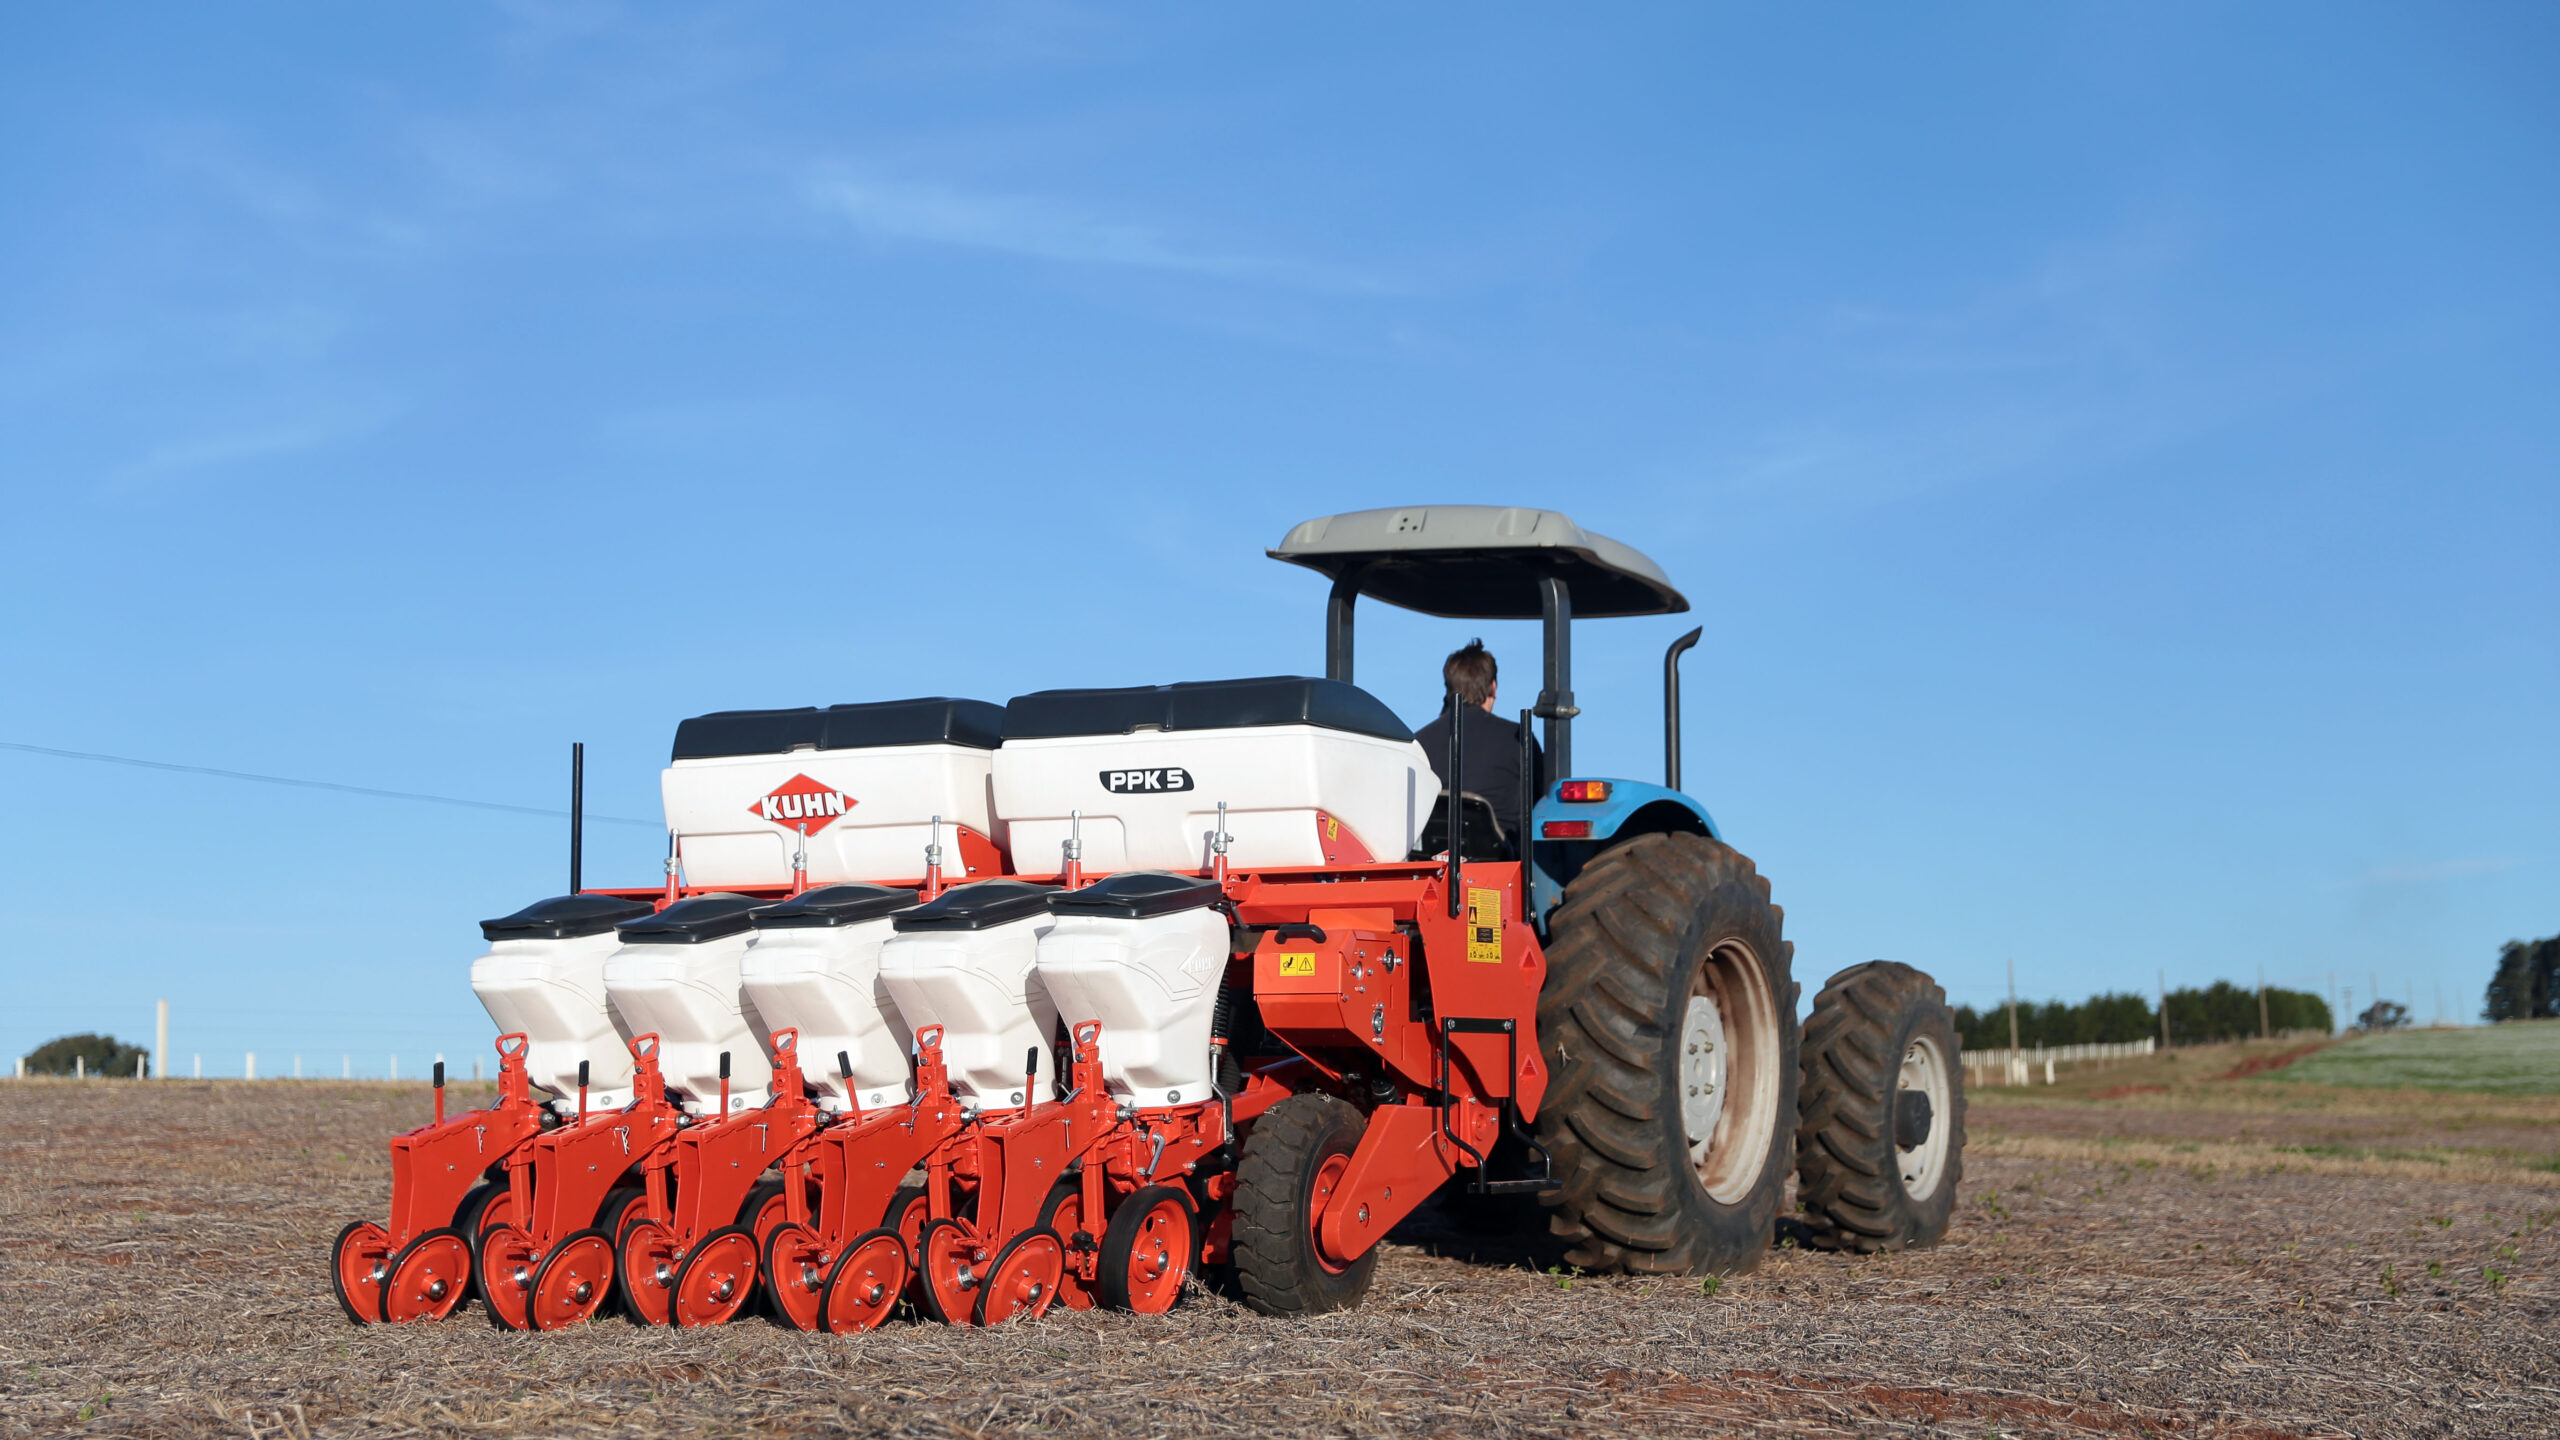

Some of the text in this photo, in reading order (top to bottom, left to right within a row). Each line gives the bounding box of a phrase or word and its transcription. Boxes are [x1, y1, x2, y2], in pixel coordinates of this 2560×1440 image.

[1109, 769, 1184, 791] PPK 5
[760, 791, 847, 820] KUHN
